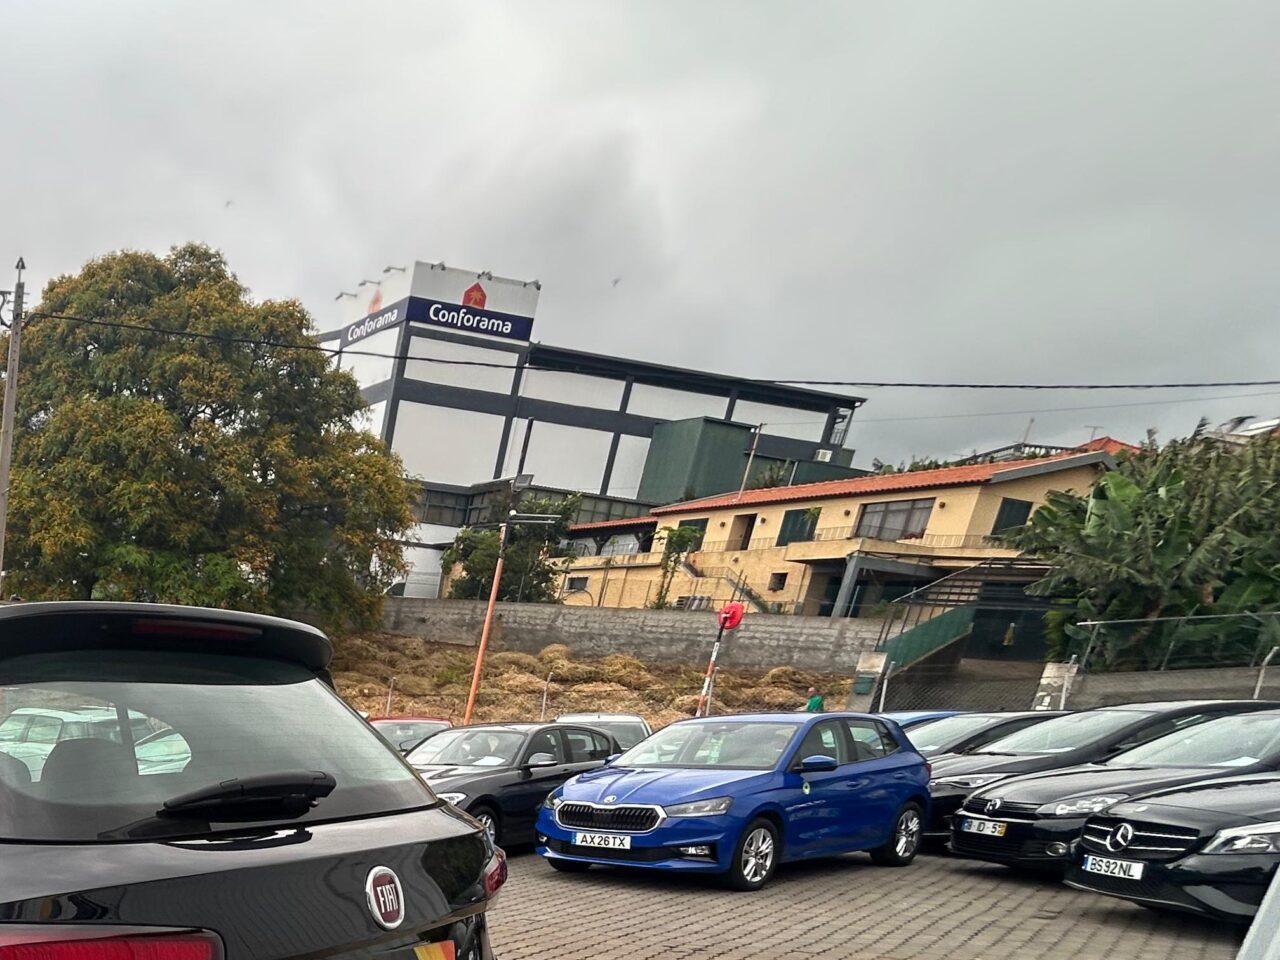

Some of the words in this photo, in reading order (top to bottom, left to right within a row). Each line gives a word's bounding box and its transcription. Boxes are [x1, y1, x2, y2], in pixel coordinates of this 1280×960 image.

[347, 308, 399, 342] Conforama
[428, 303, 513, 334] Conforama
[580, 834, 626, 848] AX26TX
[1089, 857, 1135, 878] BS92NL
[376, 883, 399, 914] FIAT
